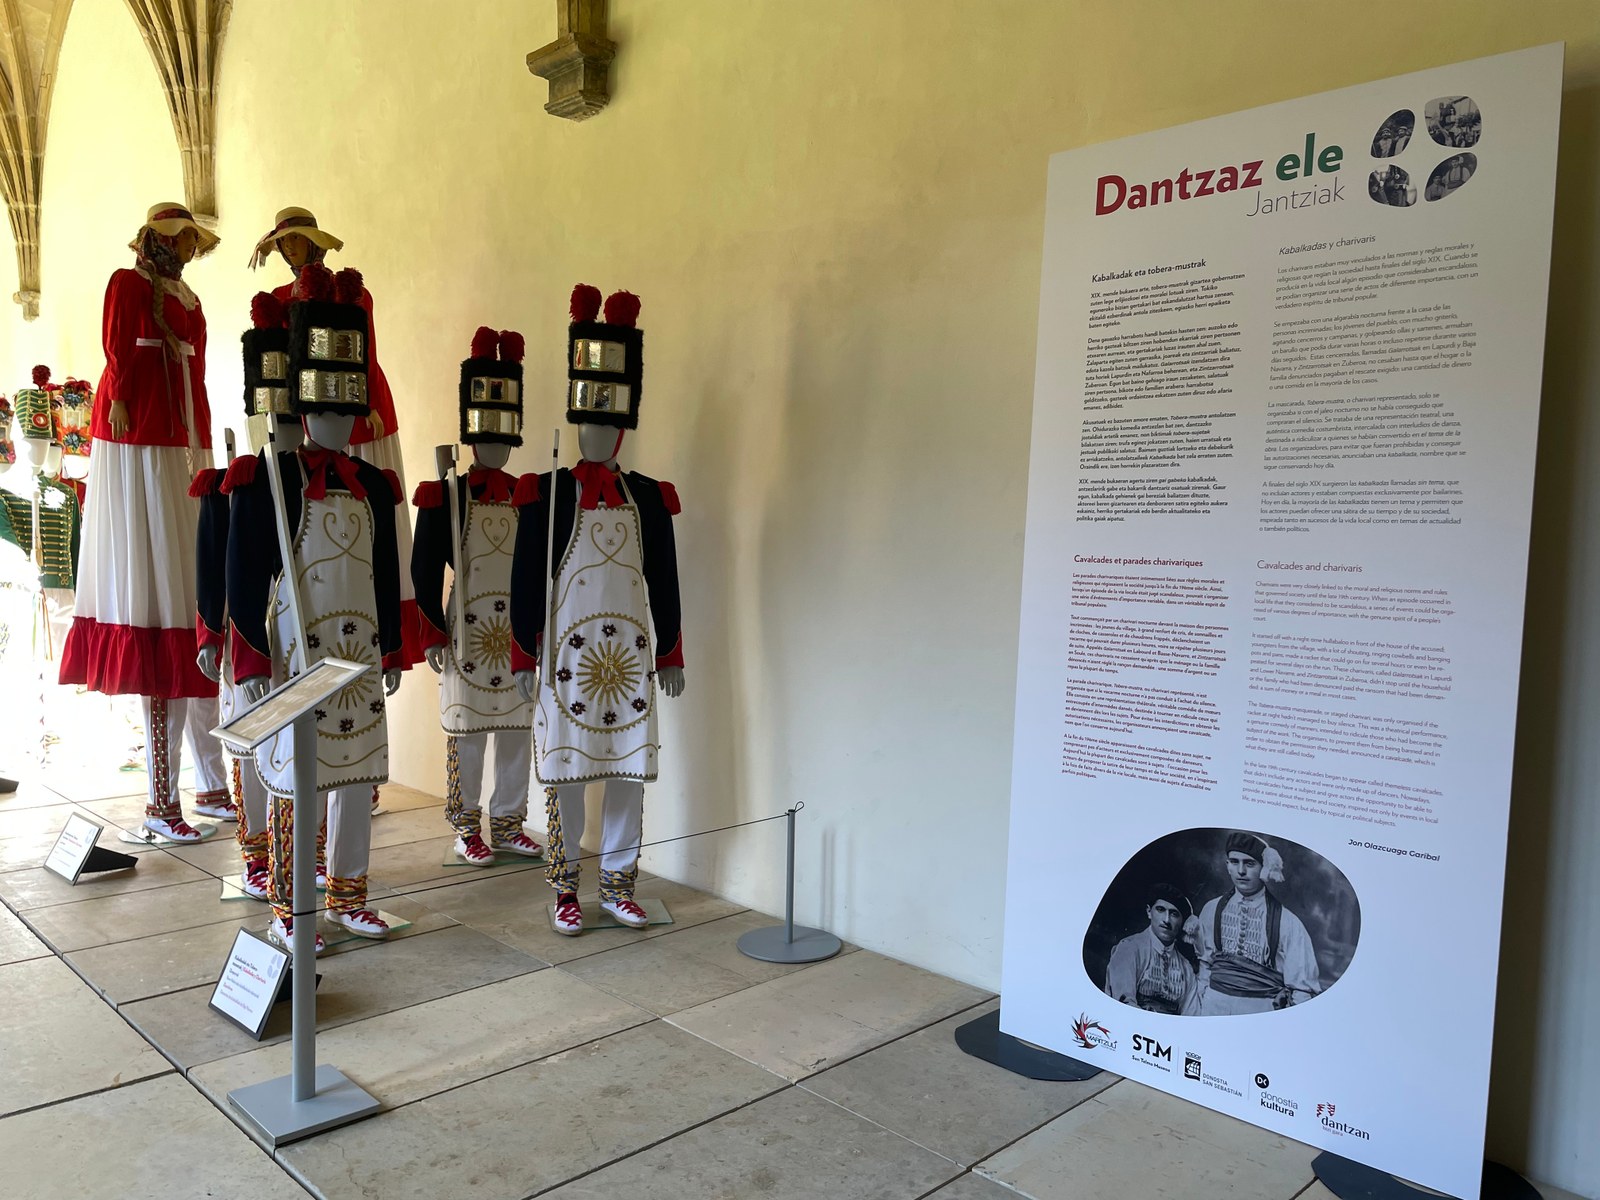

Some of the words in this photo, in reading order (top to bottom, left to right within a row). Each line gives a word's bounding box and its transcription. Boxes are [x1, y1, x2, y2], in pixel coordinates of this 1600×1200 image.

[1095, 158, 1263, 216] Dantzaz
[1275, 132, 1344, 181] ele
[1246, 178, 1344, 217] Jantziak
[1278, 242, 1327, 255] Kabalkadas
[1328, 242, 1334, 250] y
[1335, 234, 1375, 247] charivaris
[1092, 269, 1133, 282] Kabalkadak
[1148, 258, 1206, 274] tobera-mustrak
[1074, 554, 1112, 563] Cavalcades
[1122, 557, 1151, 566] parades
[1152, 557, 1203, 568] charivariques
[1257, 560, 1303, 570] Cavalcades
[1305, 562, 1321, 571] and
[1322, 562, 1362, 572] charivaris
[1364, 842, 1407, 855] Olazcuaga
[1203, 1073, 1228, 1086] DONOSTIA
[1203, 1080, 1213, 1089] SAN
[1214, 1083, 1242, 1097] SEBASTIÁN
[1260, 1099, 1294, 1117] kultura
[1261, 1091, 1298, 1109] donostia
[1322, 1116, 1370, 1140] dantzan
